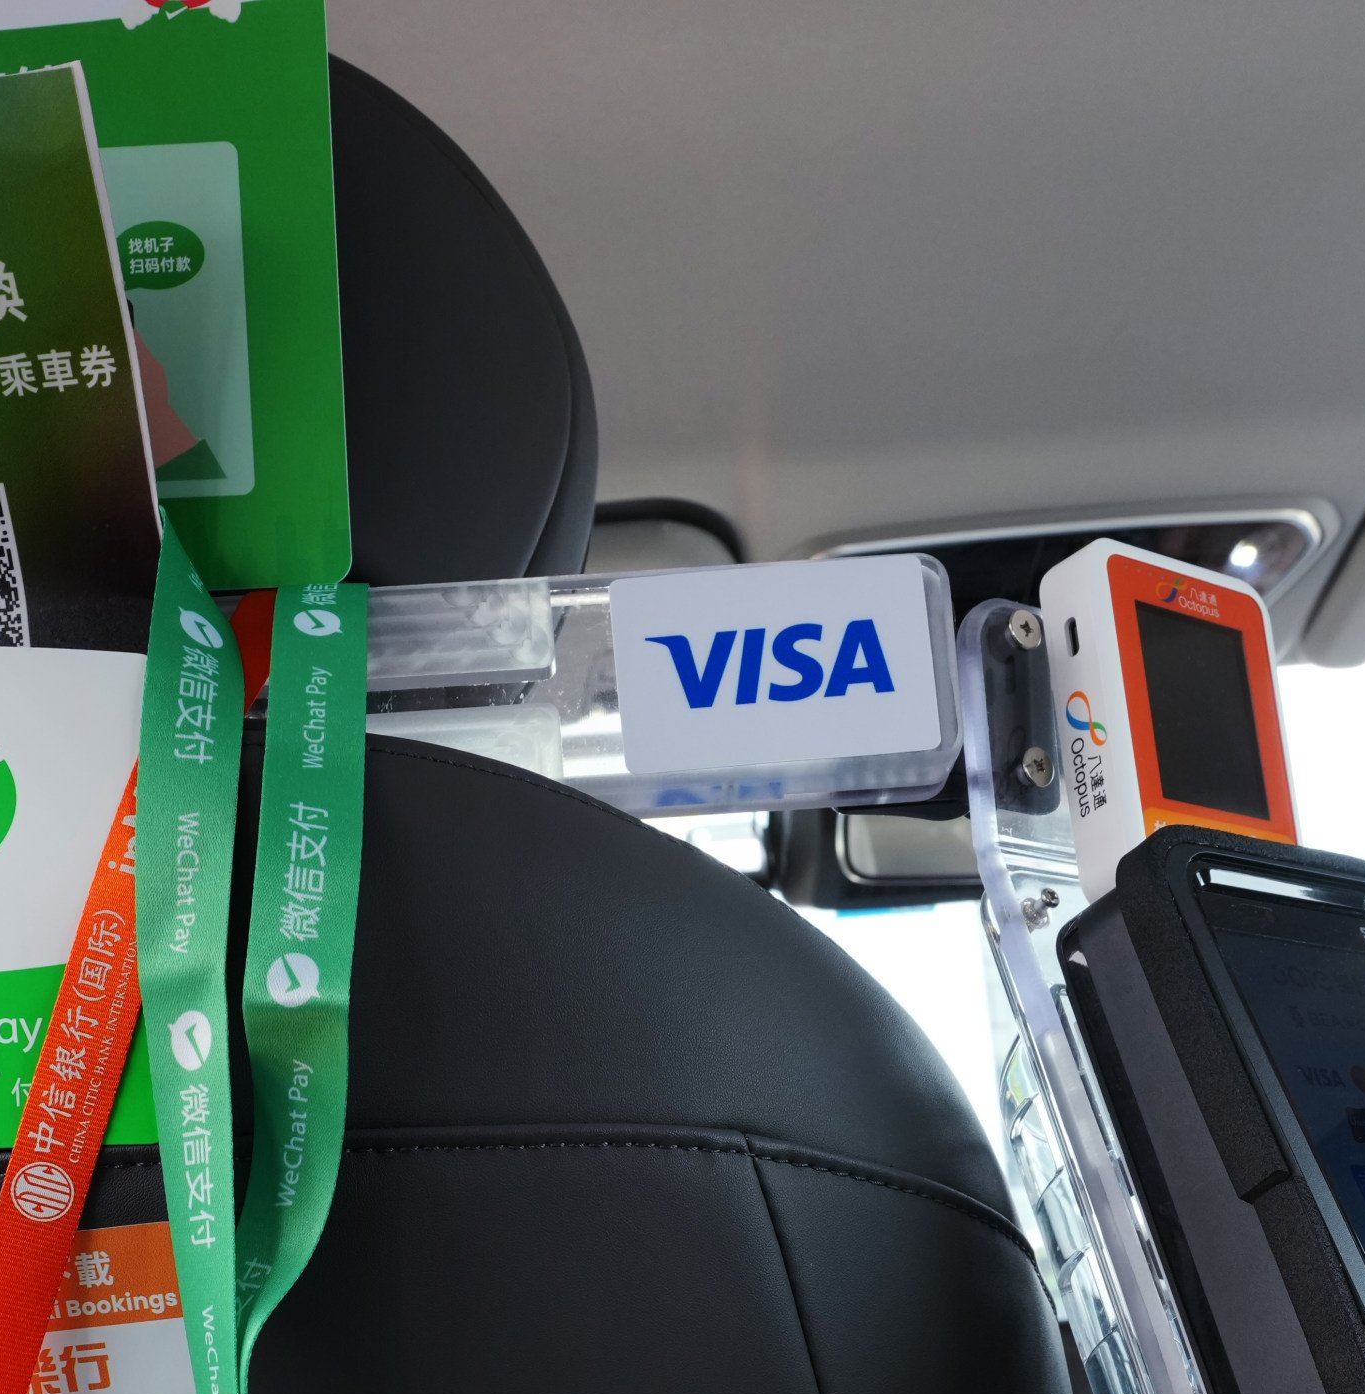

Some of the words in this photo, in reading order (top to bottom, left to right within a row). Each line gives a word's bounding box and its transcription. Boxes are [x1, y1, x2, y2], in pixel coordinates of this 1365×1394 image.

[128, 236, 174, 254] 找机子
[129, 256, 191, 274] 扫码付款
[1178, 596, 1220, 618] Octopus
[306, 666, 333, 695] Pay
[645, 619, 895, 709] VISA
[174, 646, 219, 764] 微信支付
[302, 698, 328, 769] WeChat
[1071, 738, 1090, 818] Octopus
[1087, 755, 1108, 810] 八達通
[176, 812, 201, 906] WeChat
[280, 801, 329, 941] 微信支付
[170, 912, 196, 953] Pay
[28, 909, 126, 1153] 中信银行(国际)
[69, 1119, 91, 1163] CHINA
[83, 1077, 102, 1116] CITIC
[94, 1037, 114, 1075] BANK
[288, 1060, 314, 1102] Pay
[180, 1084, 216, 1249] 微信支付
[276, 1111, 307, 1208] WeChat
[66, 1291, 178, 1316] Bookings
